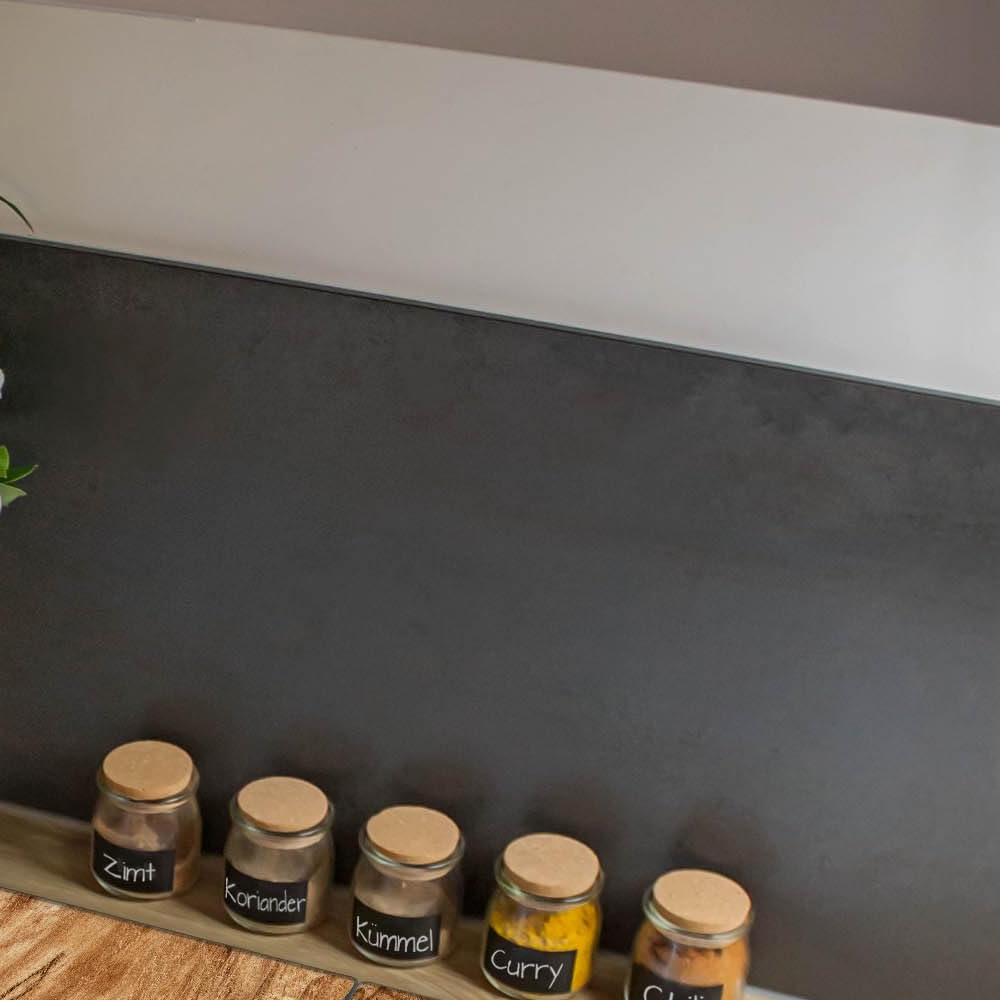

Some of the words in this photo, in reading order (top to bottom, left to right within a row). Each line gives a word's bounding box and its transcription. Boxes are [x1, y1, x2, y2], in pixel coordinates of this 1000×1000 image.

[103, 852, 156, 883] Zimt
[225, 876, 306, 913] Koriander
[356, 915, 433, 953] Kümmel
[490, 949, 564, 990] Curry
